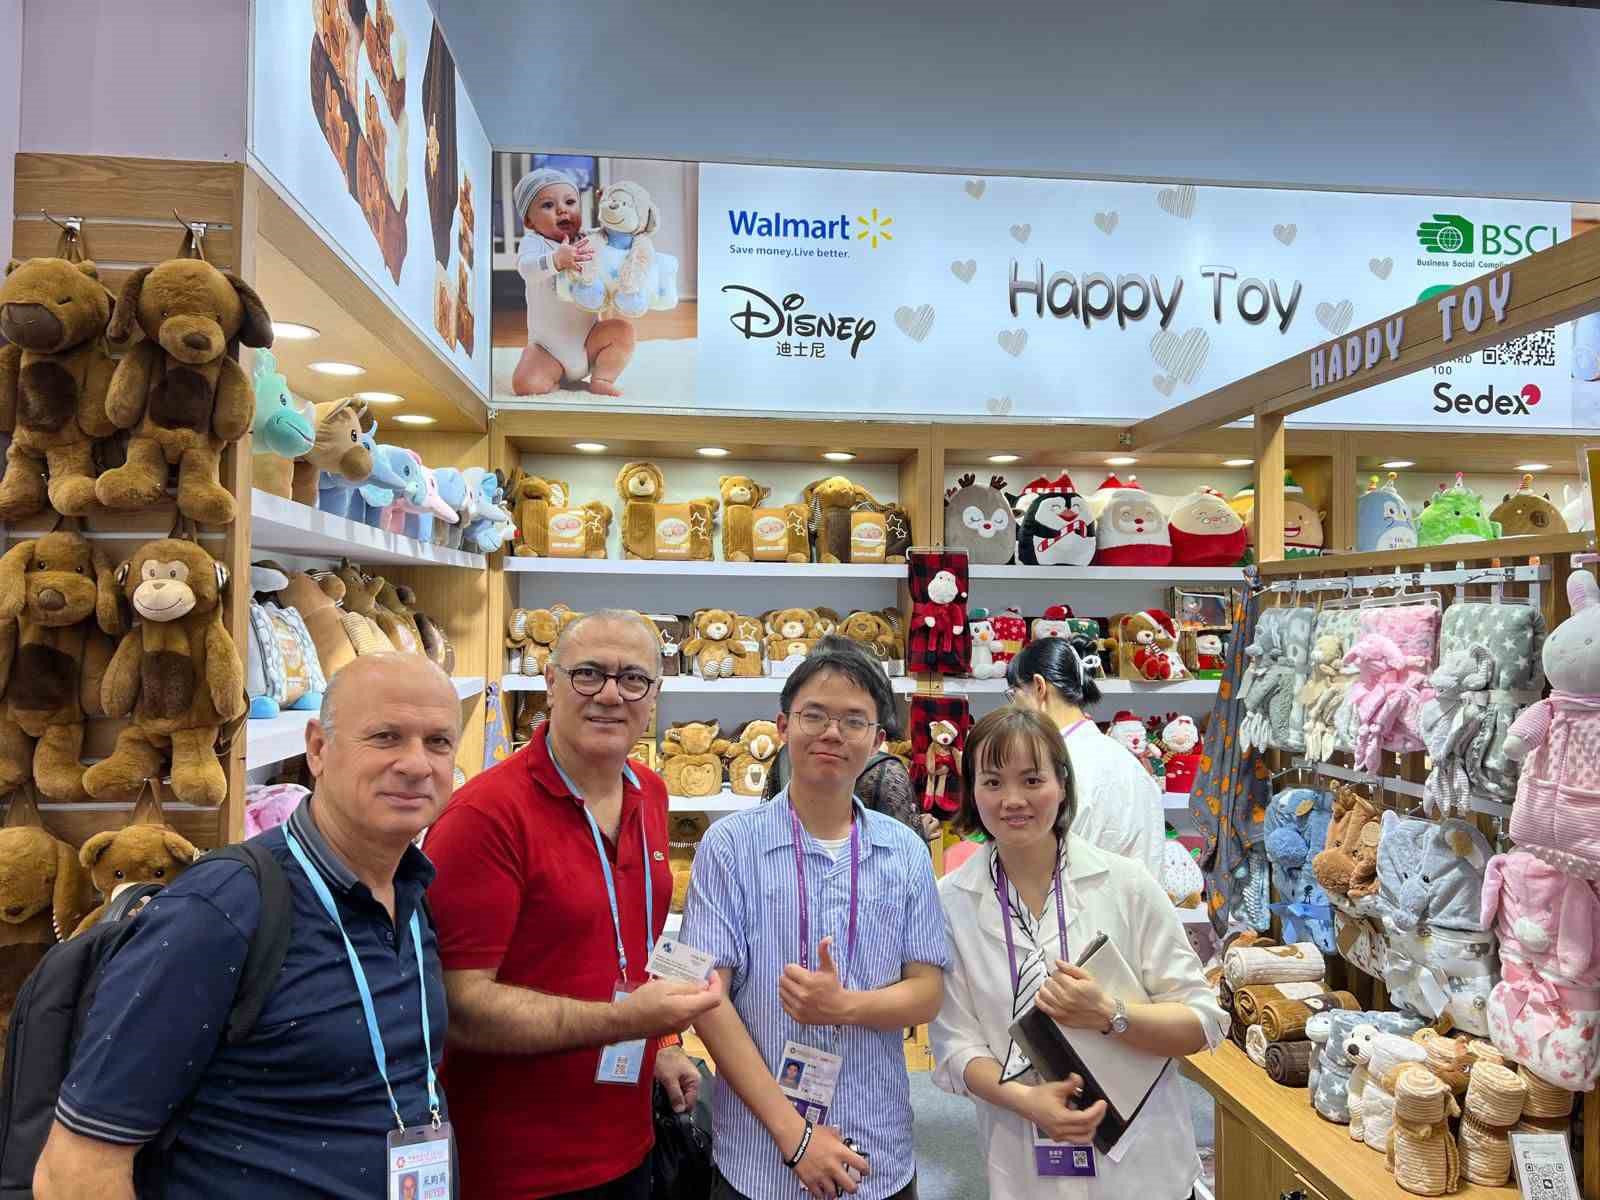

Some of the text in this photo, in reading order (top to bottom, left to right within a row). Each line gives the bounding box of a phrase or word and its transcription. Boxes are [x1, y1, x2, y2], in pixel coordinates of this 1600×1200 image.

[728, 210, 850, 240] Walmart
[1483, 224, 1557, 256] BSCI
[729, 244, 753, 253] Save
[816, 248, 850, 259] better.
[1417, 259, 1449, 268] Business
[1452, 261, 1475, 270] Social
[1008, 258, 1304, 334] Happy Toy
[1310, 271, 1512, 389] HAPPY TOY
[776, 341, 826, 358] 迪士尼
[1433, 366, 1452, 375] 100
[1433, 382, 1530, 415] Sedex
